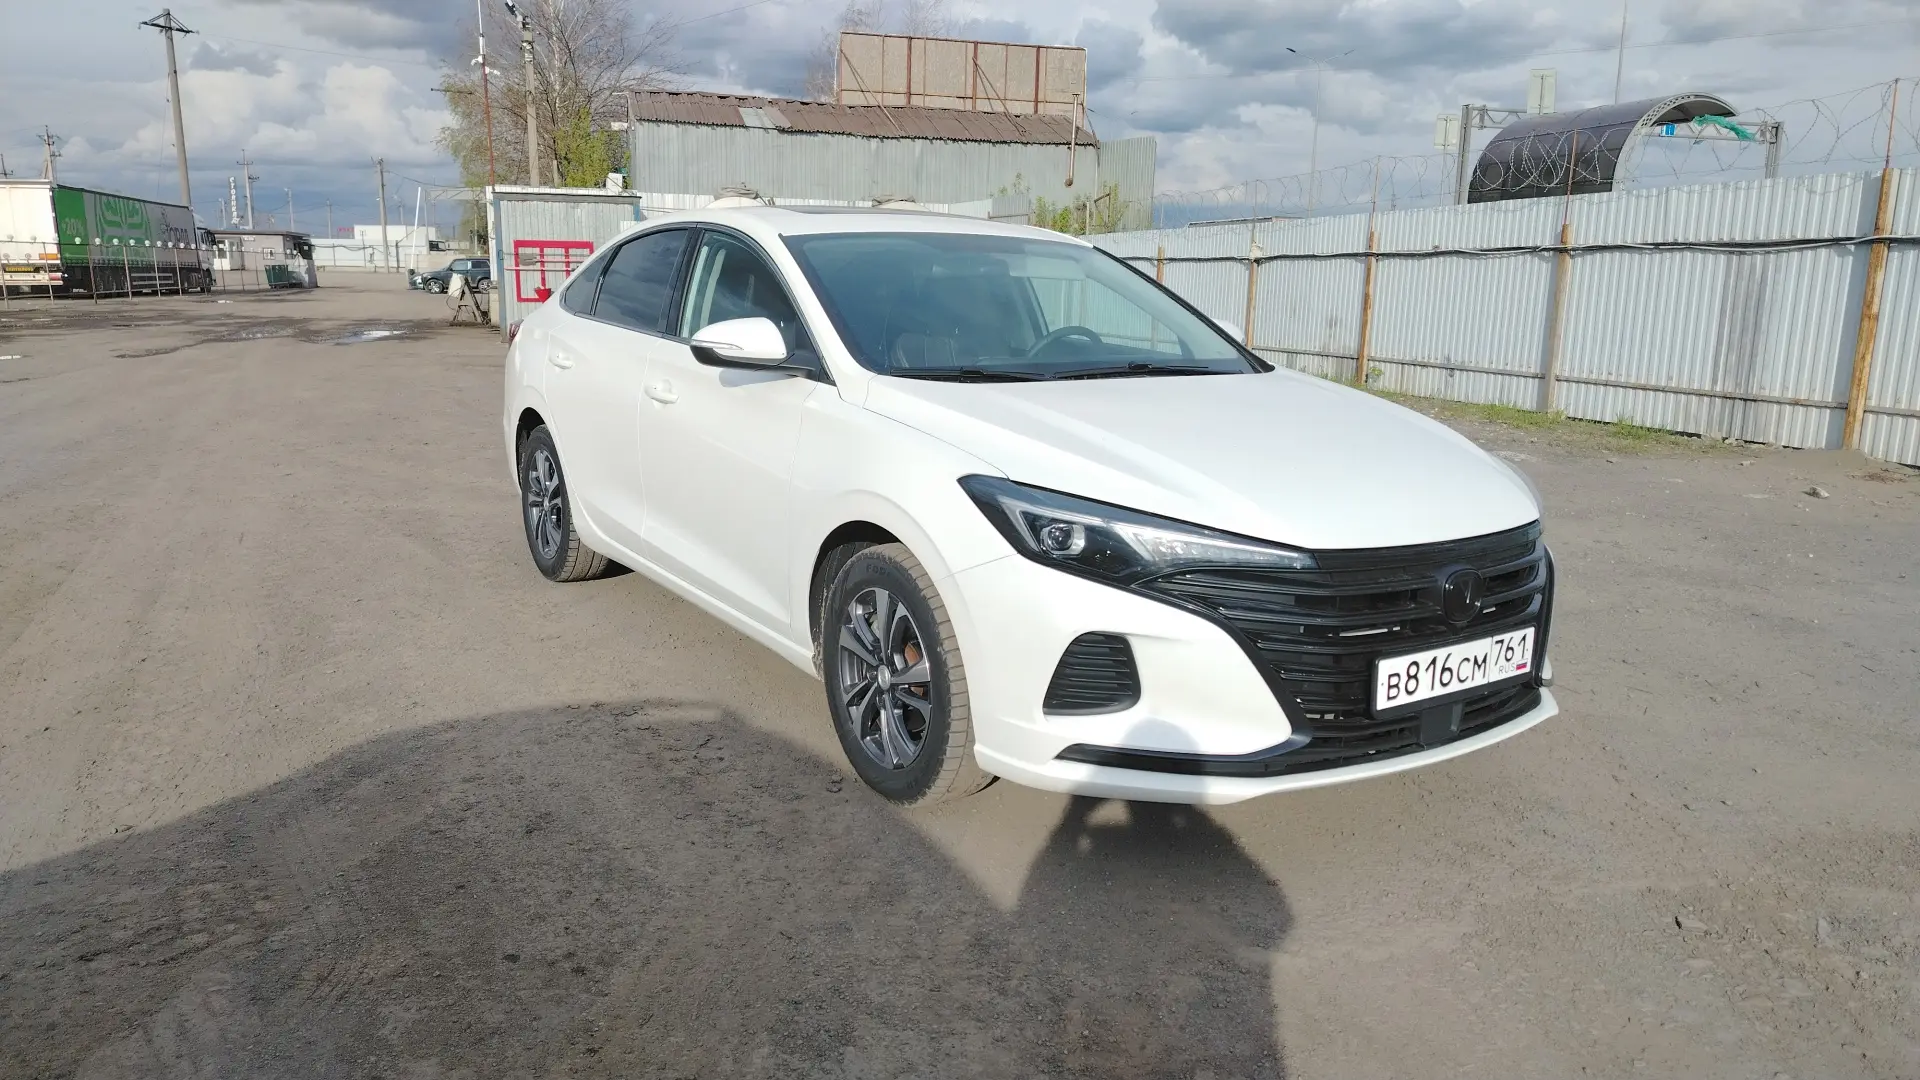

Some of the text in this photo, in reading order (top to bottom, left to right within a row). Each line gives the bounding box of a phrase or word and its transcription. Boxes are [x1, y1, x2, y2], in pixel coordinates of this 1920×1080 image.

[1386, 633, 1528, 701] В816СМ 761
[1498, 661, 1516, 675] RUS
